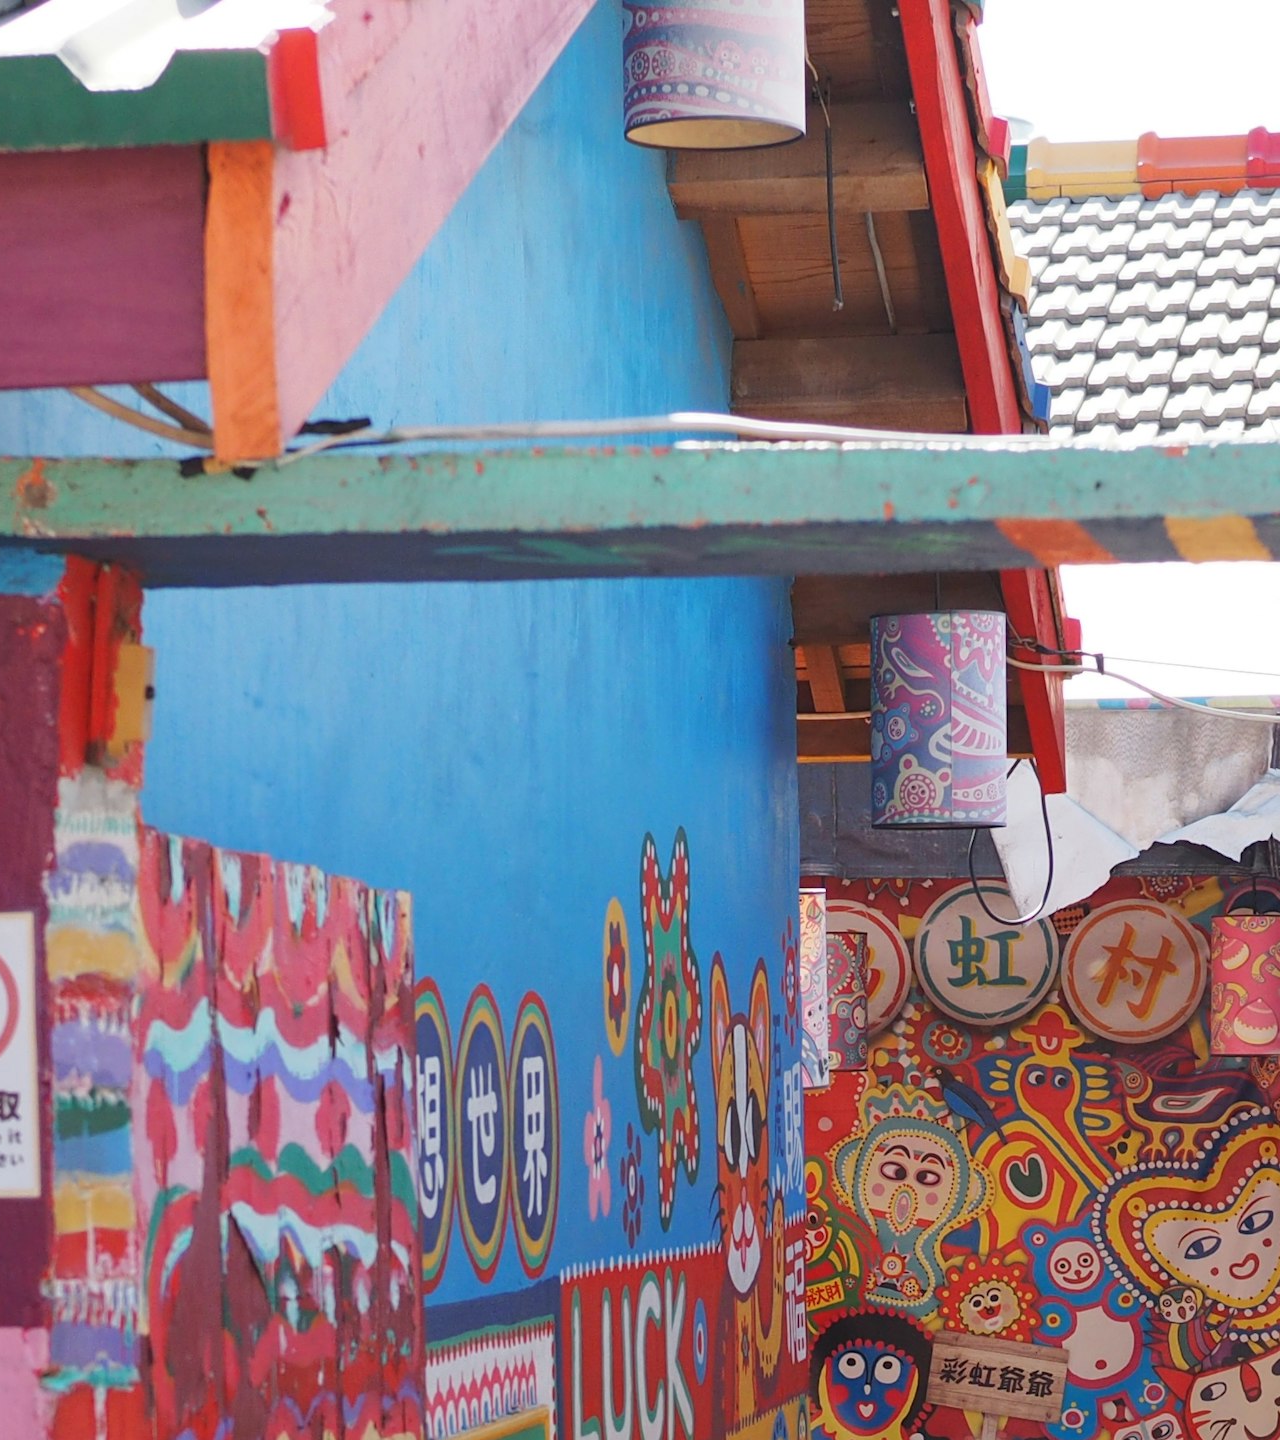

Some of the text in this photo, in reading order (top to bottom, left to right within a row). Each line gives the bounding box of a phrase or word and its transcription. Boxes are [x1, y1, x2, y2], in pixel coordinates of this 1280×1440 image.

[7, 1128, 23, 1145] it
[939, 1357, 1055, 1398] 彩虹爺爺
